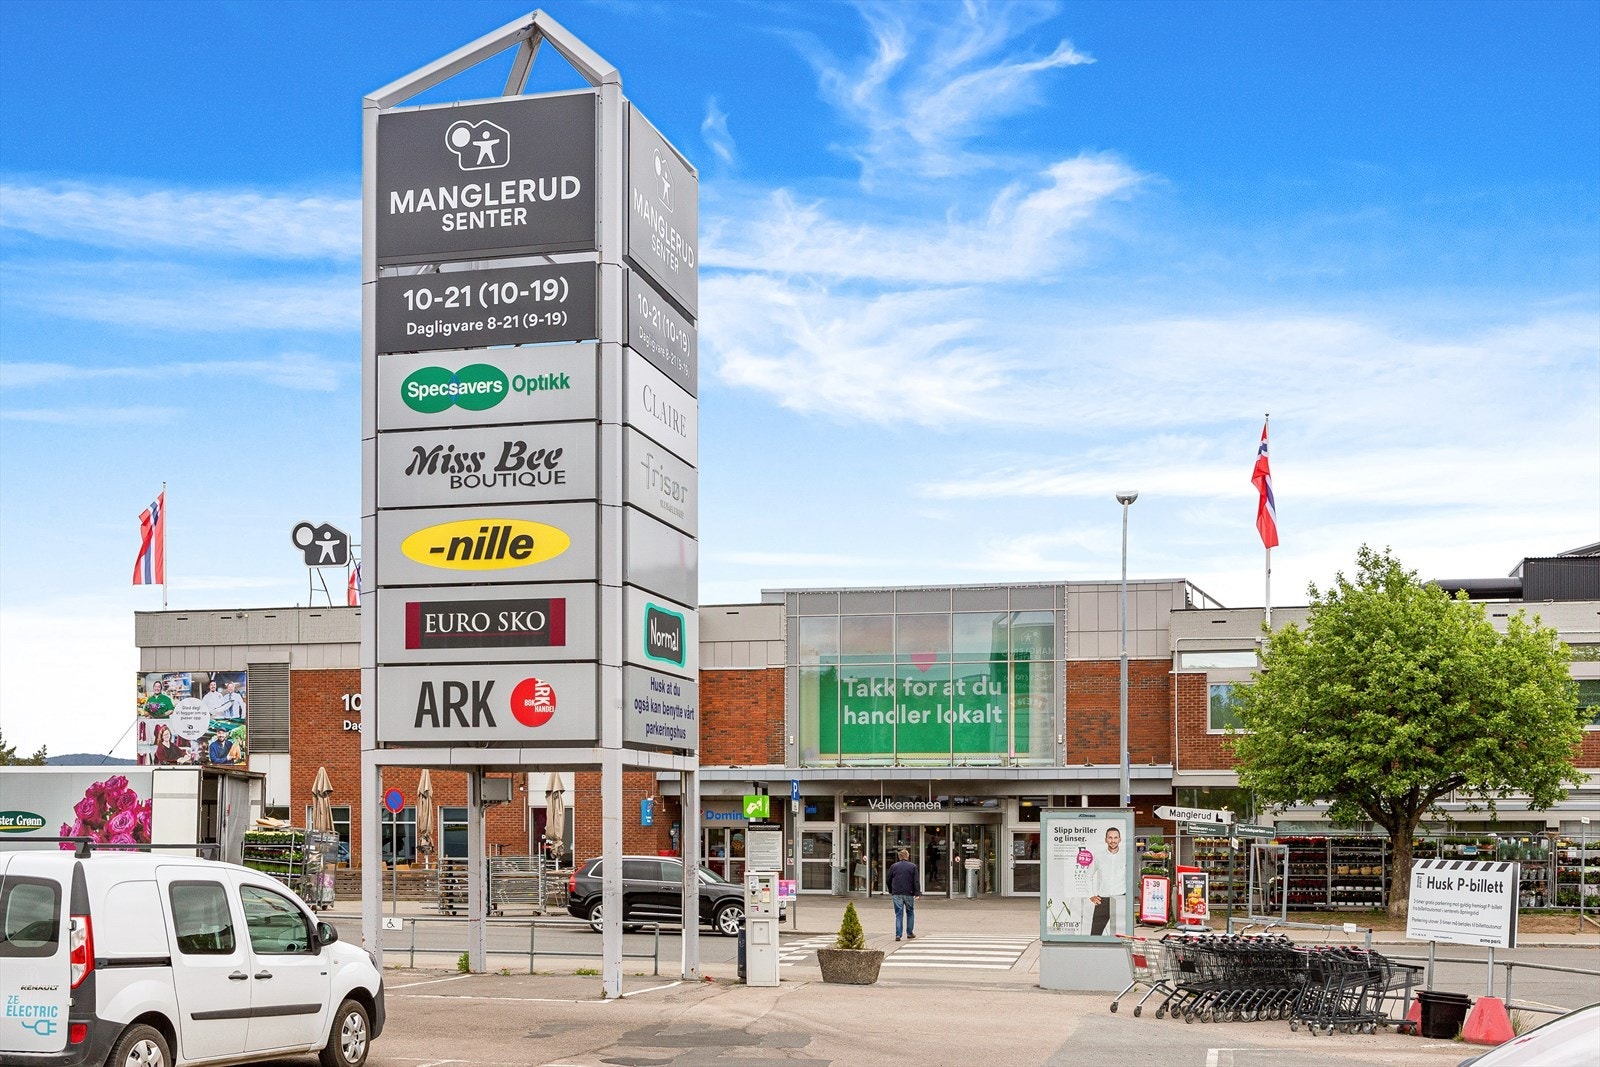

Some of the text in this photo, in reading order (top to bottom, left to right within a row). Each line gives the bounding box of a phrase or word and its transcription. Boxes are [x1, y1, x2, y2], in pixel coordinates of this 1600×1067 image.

[389, 175, 581, 215] MANGLERUD
[441, 207, 527, 232] SENTER
[633, 187, 694, 268] MANGLERUD
[651, 233, 679, 274] SENTER
[403, 276, 569, 311] 10-21 (10-19)
[406, 310, 568, 338] Dagligvare 8-21 (9-19)
[638, 293, 691, 357] 10-21 (10-19)
[407, 372, 571, 401] Specsavers Optikk
[642, 384, 686, 438] CLAIRE
[404, 440, 564, 476] Miss Bee
[449, 469, 567, 490] BOUTIQUE
[640, 452, 688, 504] frisør
[429, 525, 535, 561] -nille
[424, 609, 546, 634] EURO SKO
[650, 617, 679, 652] Normal
[650, 676, 681, 697] Husk at du
[843, 677, 896, 697] Takk
[903, 676, 937, 696] for
[943, 679, 966, 696] at
[972, 675, 1002, 696] du
[413, 679, 498, 728] ARK
[634, 696, 695, 721] også kan benytte vårt
[843, 703, 1002, 725] handler lokalt
[645, 721, 687, 741] parkeringshus
[792, 782, 798, 798] P
[868, 798, 942, 810] Velkommen
[1169, 808, 1212, 821] Manglerud
[16, 815, 43, 827] Grønn
[1054, 826, 1098, 834] Slipp briller
[1426, 875, 1454, 891] Husk
[1457, 877, 1504, 893] P-billett
[1053, 920, 1080, 928] memira
[6, 1005, 58, 1018] ELECTRIC
